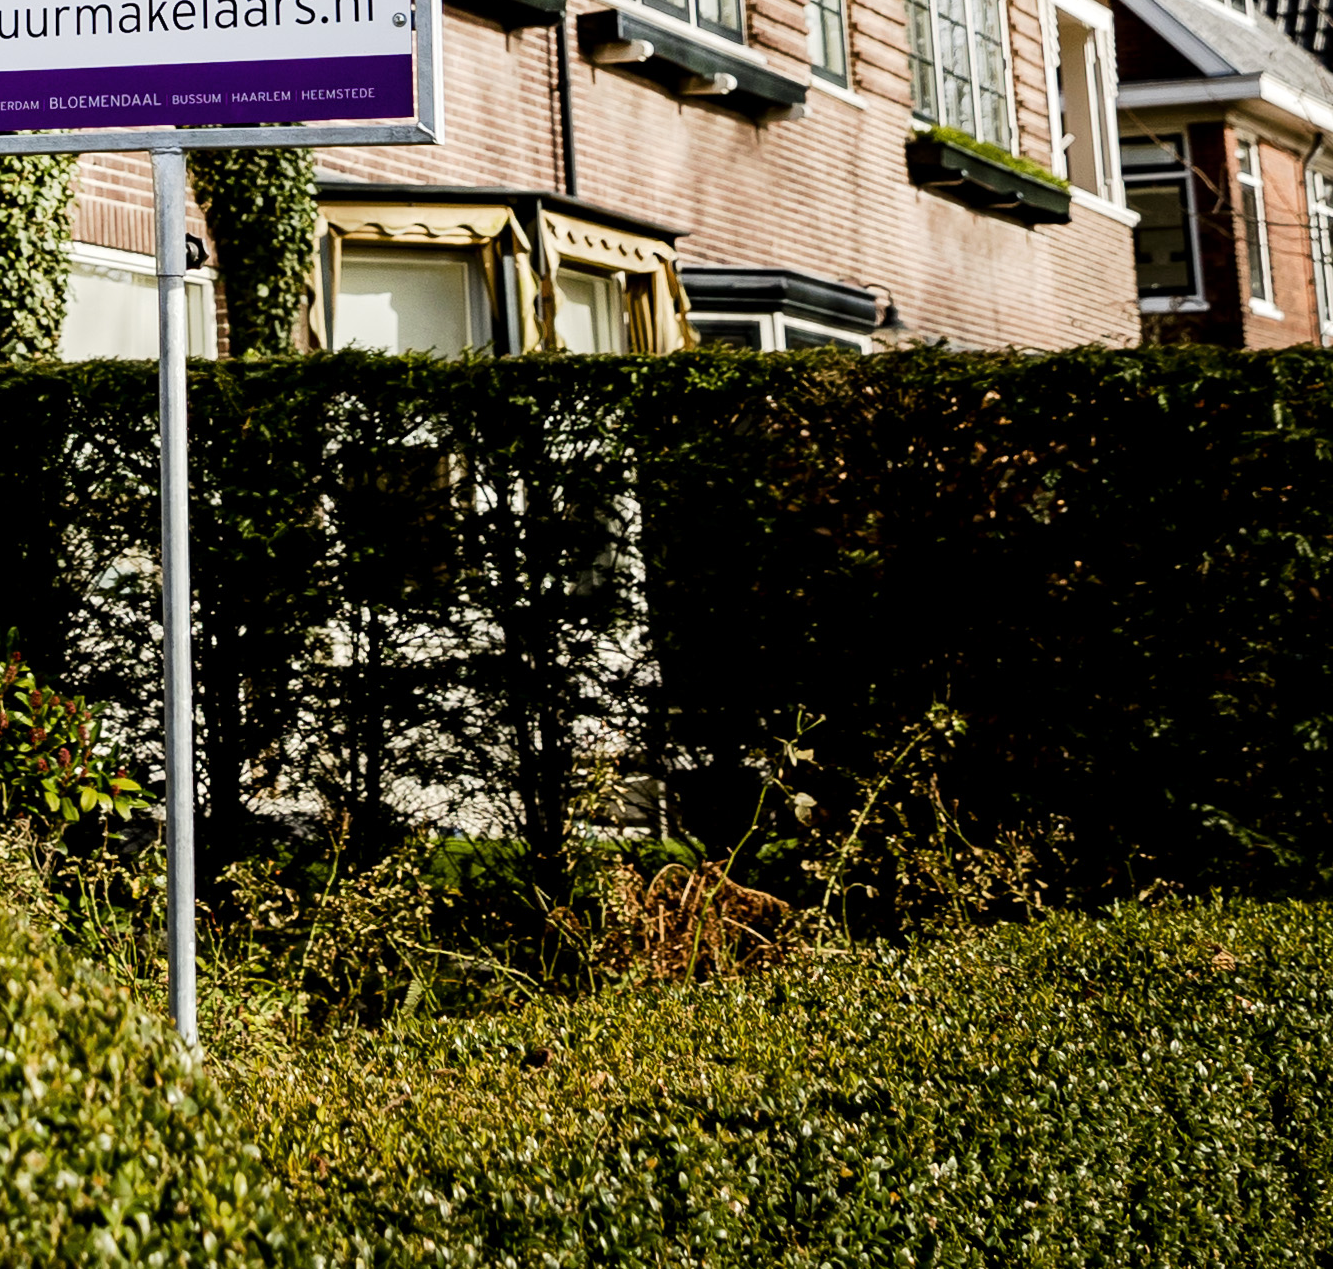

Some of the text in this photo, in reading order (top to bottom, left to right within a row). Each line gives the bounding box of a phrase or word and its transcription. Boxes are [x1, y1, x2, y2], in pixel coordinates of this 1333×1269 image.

[49, 93, 162, 110] BLOEMENDAAL
[172, 93, 222, 105] BUSSUM
[231, 90, 291, 103] HAARLEM
[301, 87, 375, 101] HEEMSTEDE
